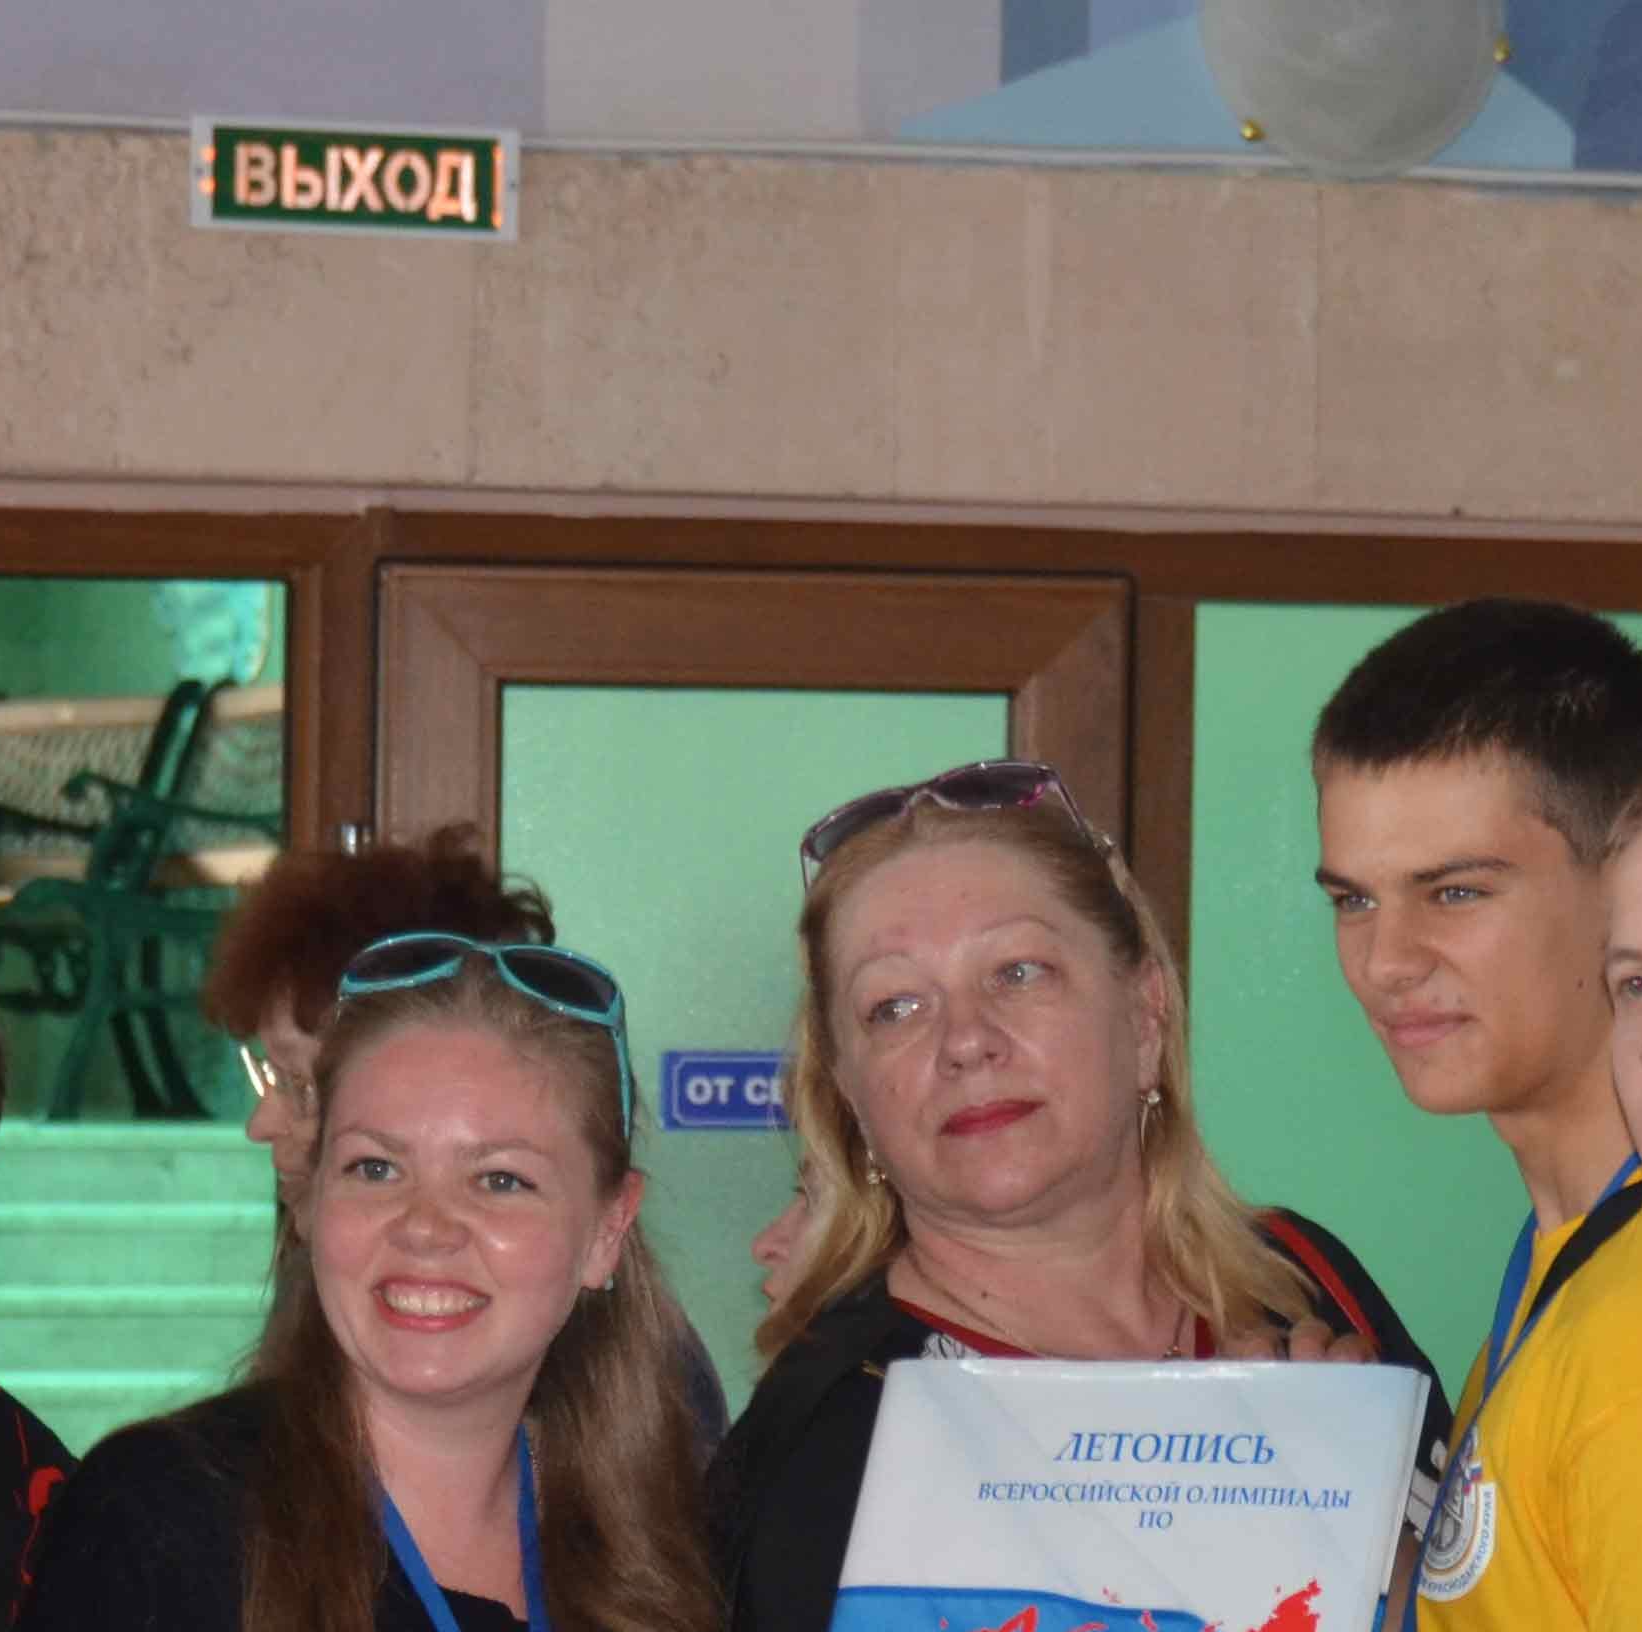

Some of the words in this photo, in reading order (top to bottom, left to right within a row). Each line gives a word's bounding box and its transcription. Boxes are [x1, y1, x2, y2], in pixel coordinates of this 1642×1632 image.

[232, 142, 477, 222] ВЫХОД
[686, 1076, 734, 1105] ОТ
[1054, 1433, 1276, 1466] ЛЕТОПИСЬ
[977, 1481, 1180, 1506] ВСЕРОССИЙСКОЙ
[1186, 1486, 1352, 1509] ОЛИМПИАДЫ
[1136, 1512, 1173, 1530] ПО
